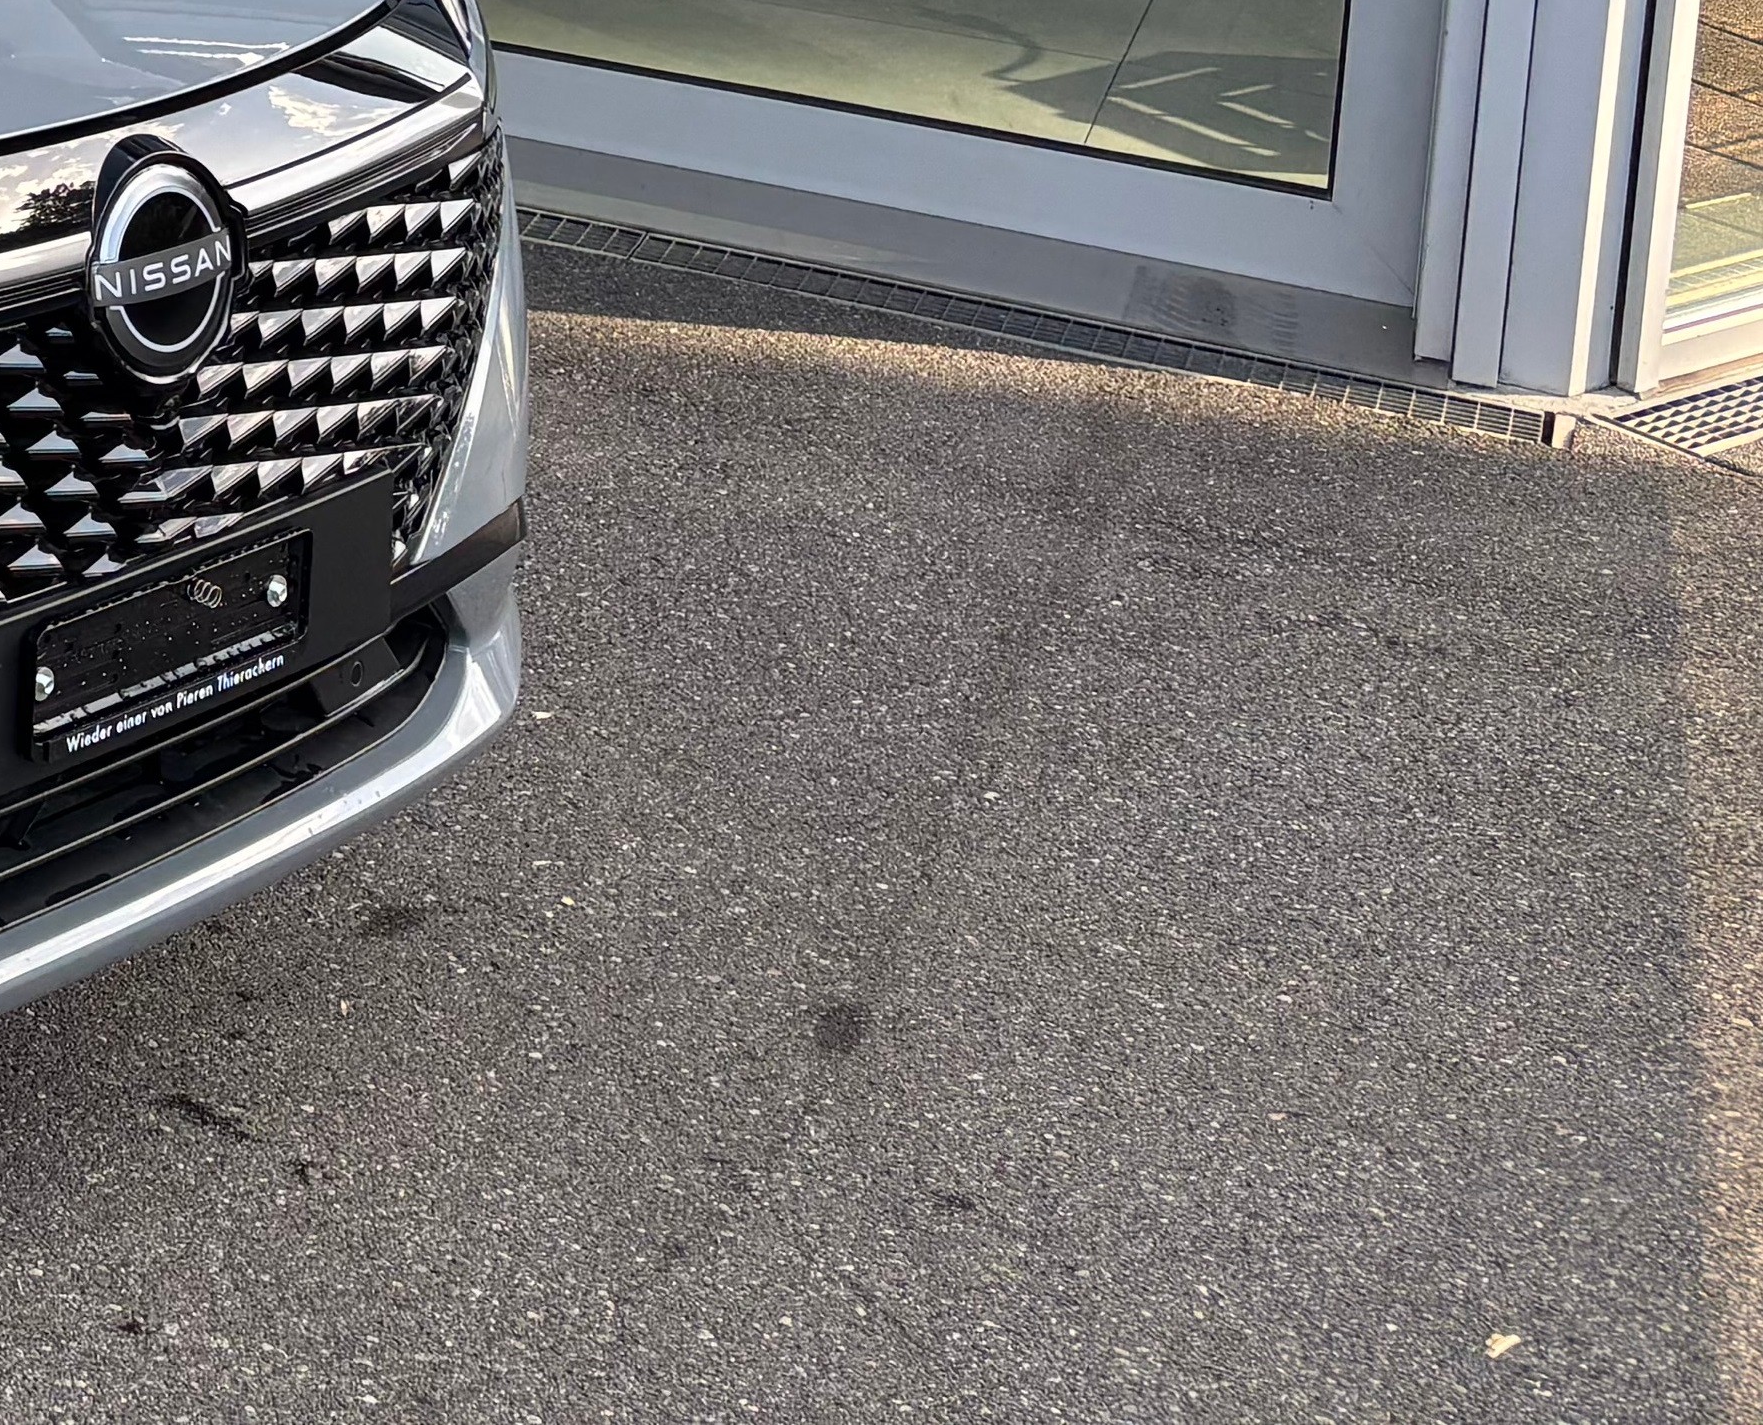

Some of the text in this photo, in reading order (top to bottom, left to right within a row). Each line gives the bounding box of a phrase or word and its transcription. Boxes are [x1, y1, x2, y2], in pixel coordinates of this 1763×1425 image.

[94, 234, 232, 301] NISSAN
[66, 653, 285, 753] Wieder einer von Pieren Thierachern
